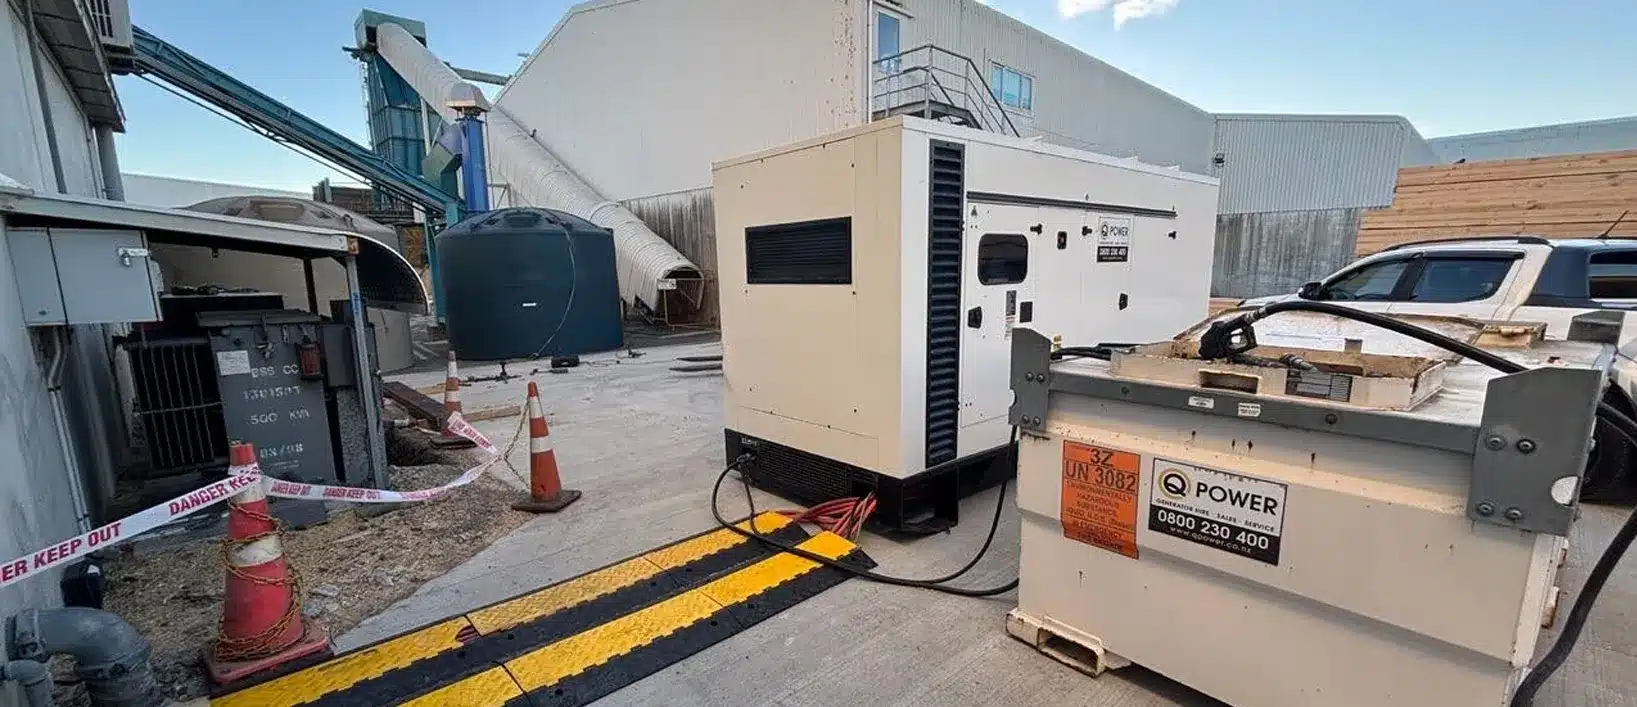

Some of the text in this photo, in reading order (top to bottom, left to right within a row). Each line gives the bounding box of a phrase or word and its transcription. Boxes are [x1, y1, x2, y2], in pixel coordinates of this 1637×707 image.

[250, 412, 278, 425] 500
[1090, 448, 1115, 467] 3Z
[1066, 459, 1137, 492] UN 3082
[168, 484, 230, 517] DANGER
[1156, 498, 1275, 533] GENERATOR HIRE SALES SERVICE
[1196, 482, 1279, 516] POWER
[34, 538, 82, 570] KEEP
[87, 522, 122, 548] OUT
[1157, 509, 1270, 550] 0800 230 400
